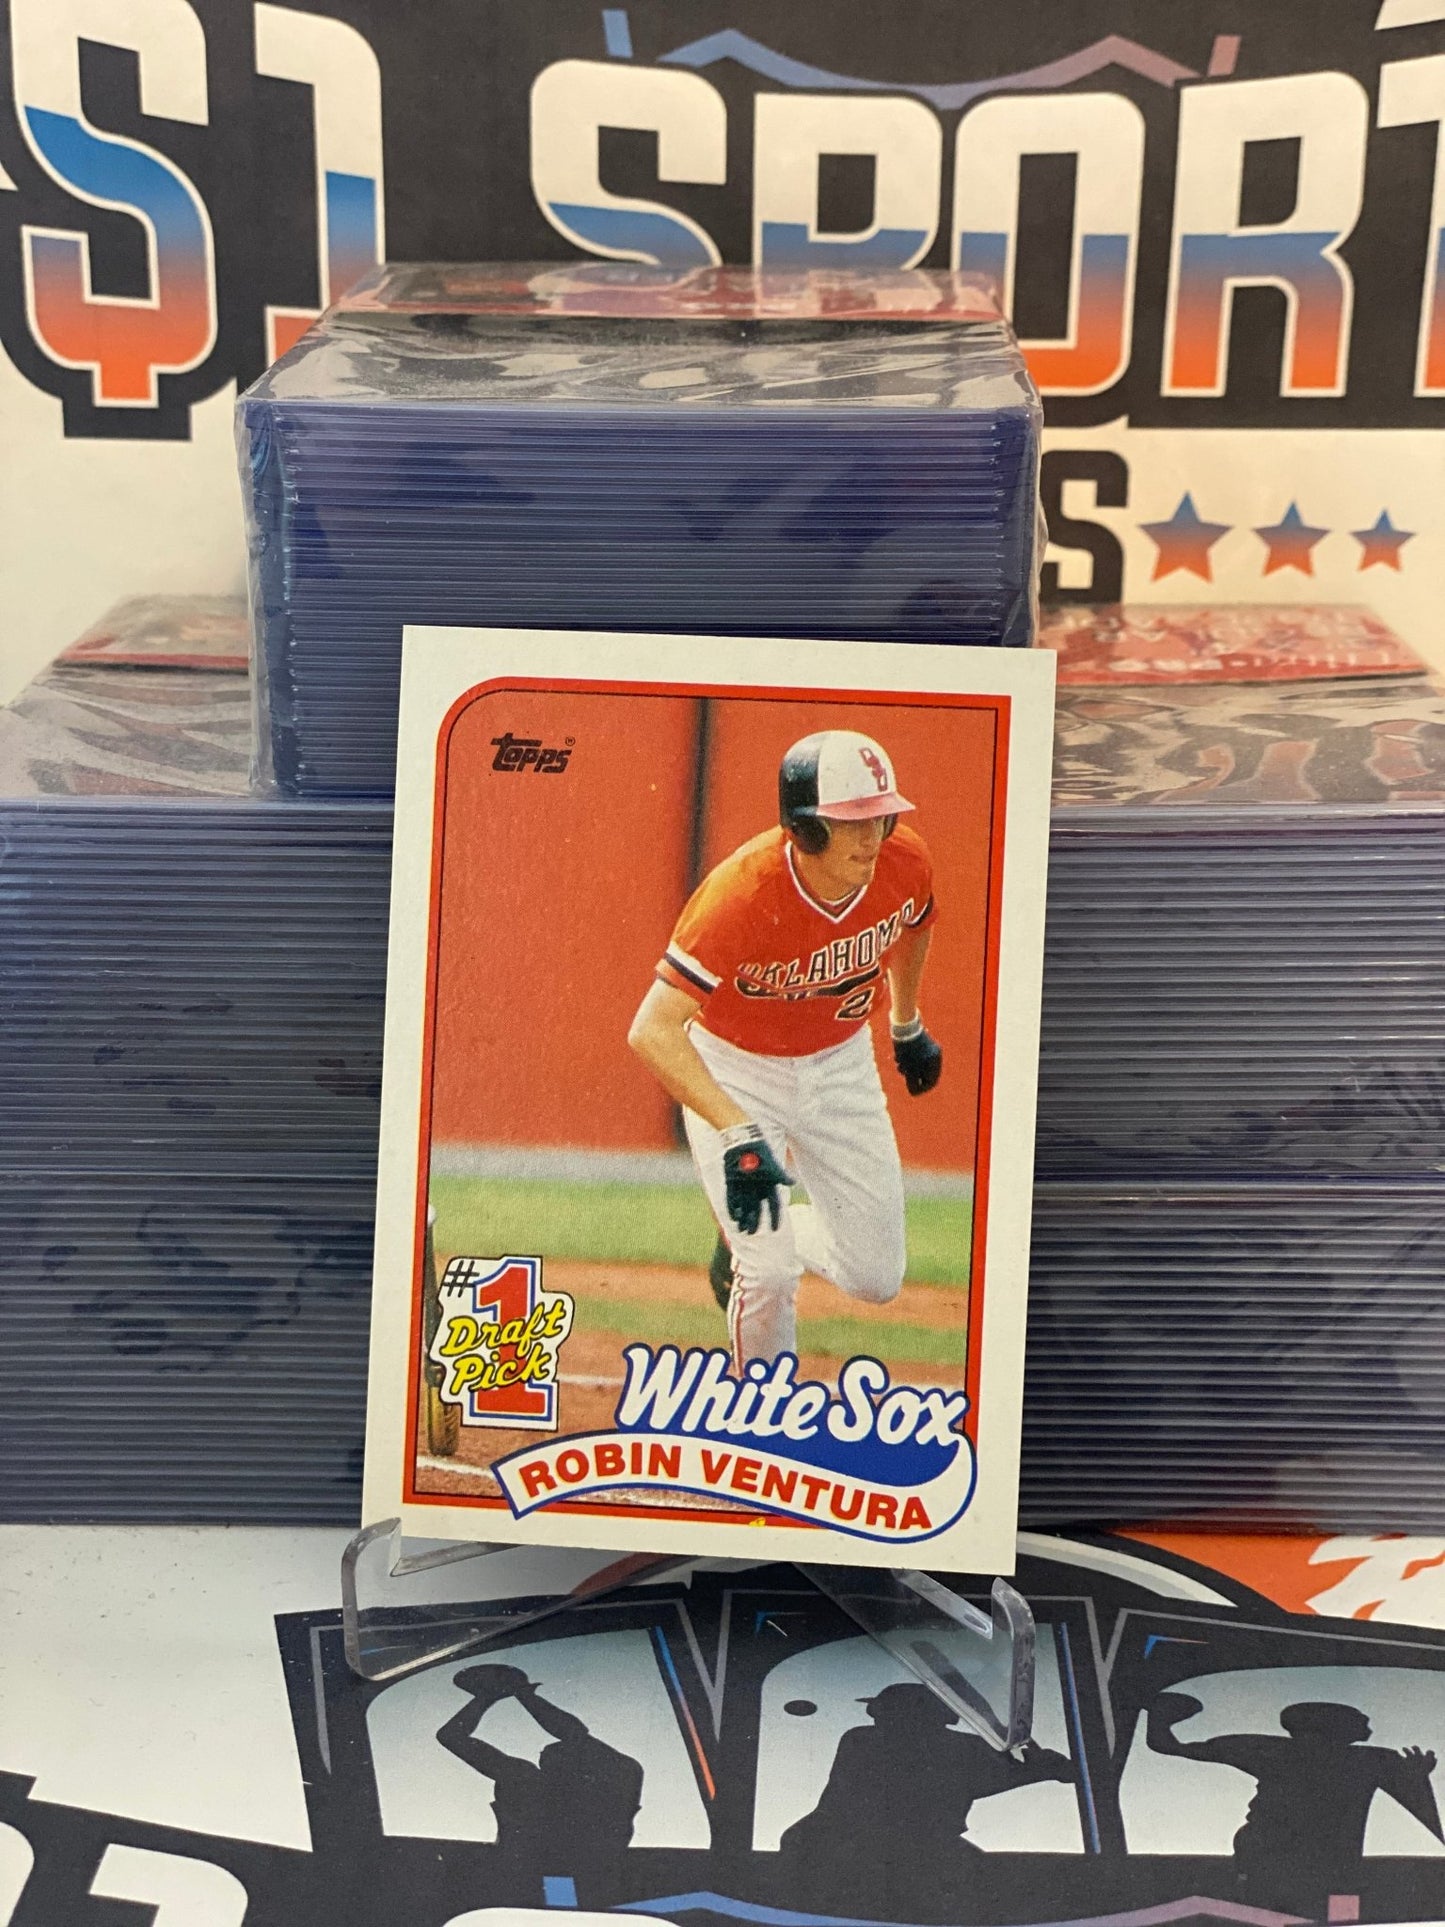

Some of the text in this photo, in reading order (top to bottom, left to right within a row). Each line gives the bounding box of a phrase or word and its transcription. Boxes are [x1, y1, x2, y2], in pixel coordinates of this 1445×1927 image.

[10, 0, 386, 408] $1
[834, 986, 876, 1021] 2
[439, 1298, 567, 1360] Draft
[449, 1342, 553, 1396] Pick
[619, 1346, 968, 1448] White Sox
[518, 1441, 933, 1532] ROBIN VENTURA
